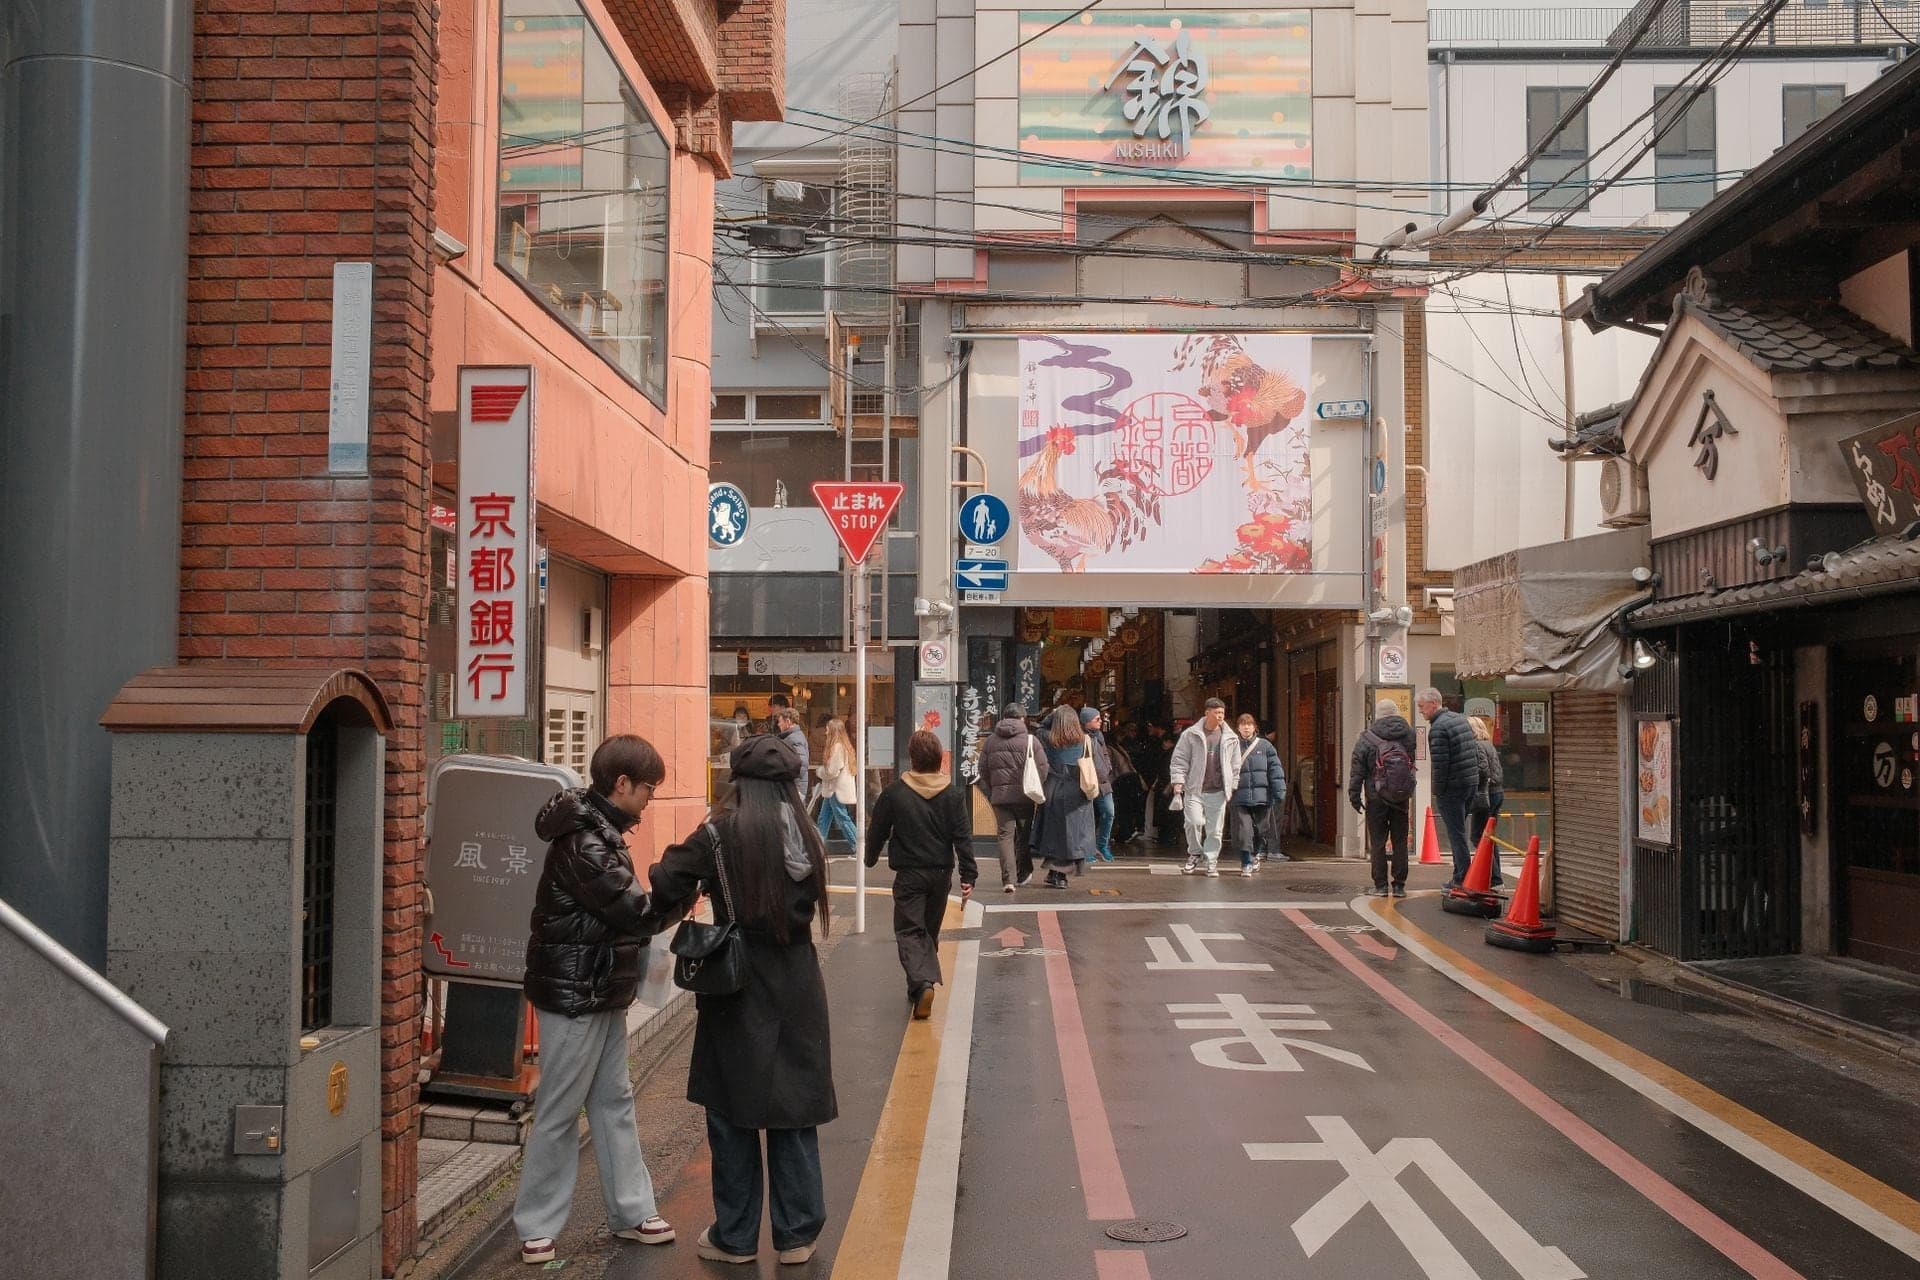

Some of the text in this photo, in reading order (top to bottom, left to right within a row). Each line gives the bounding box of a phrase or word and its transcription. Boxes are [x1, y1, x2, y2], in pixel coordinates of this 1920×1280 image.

[1103, 29, 1211, 158] 錦
[1115, 143, 1179, 159] NISHIKI
[832, 491, 886, 510] 止まれ
[841, 514, 878, 530] STOP
[467, 491, 517, 702] 京都銀行
[985, 674, 999, 715] おかき処
[960, 685, 983, 785] 寺子屋本舗
[453, 841, 535, 875] 風景
[1144, 923, 1590, 1280] 止まれ
